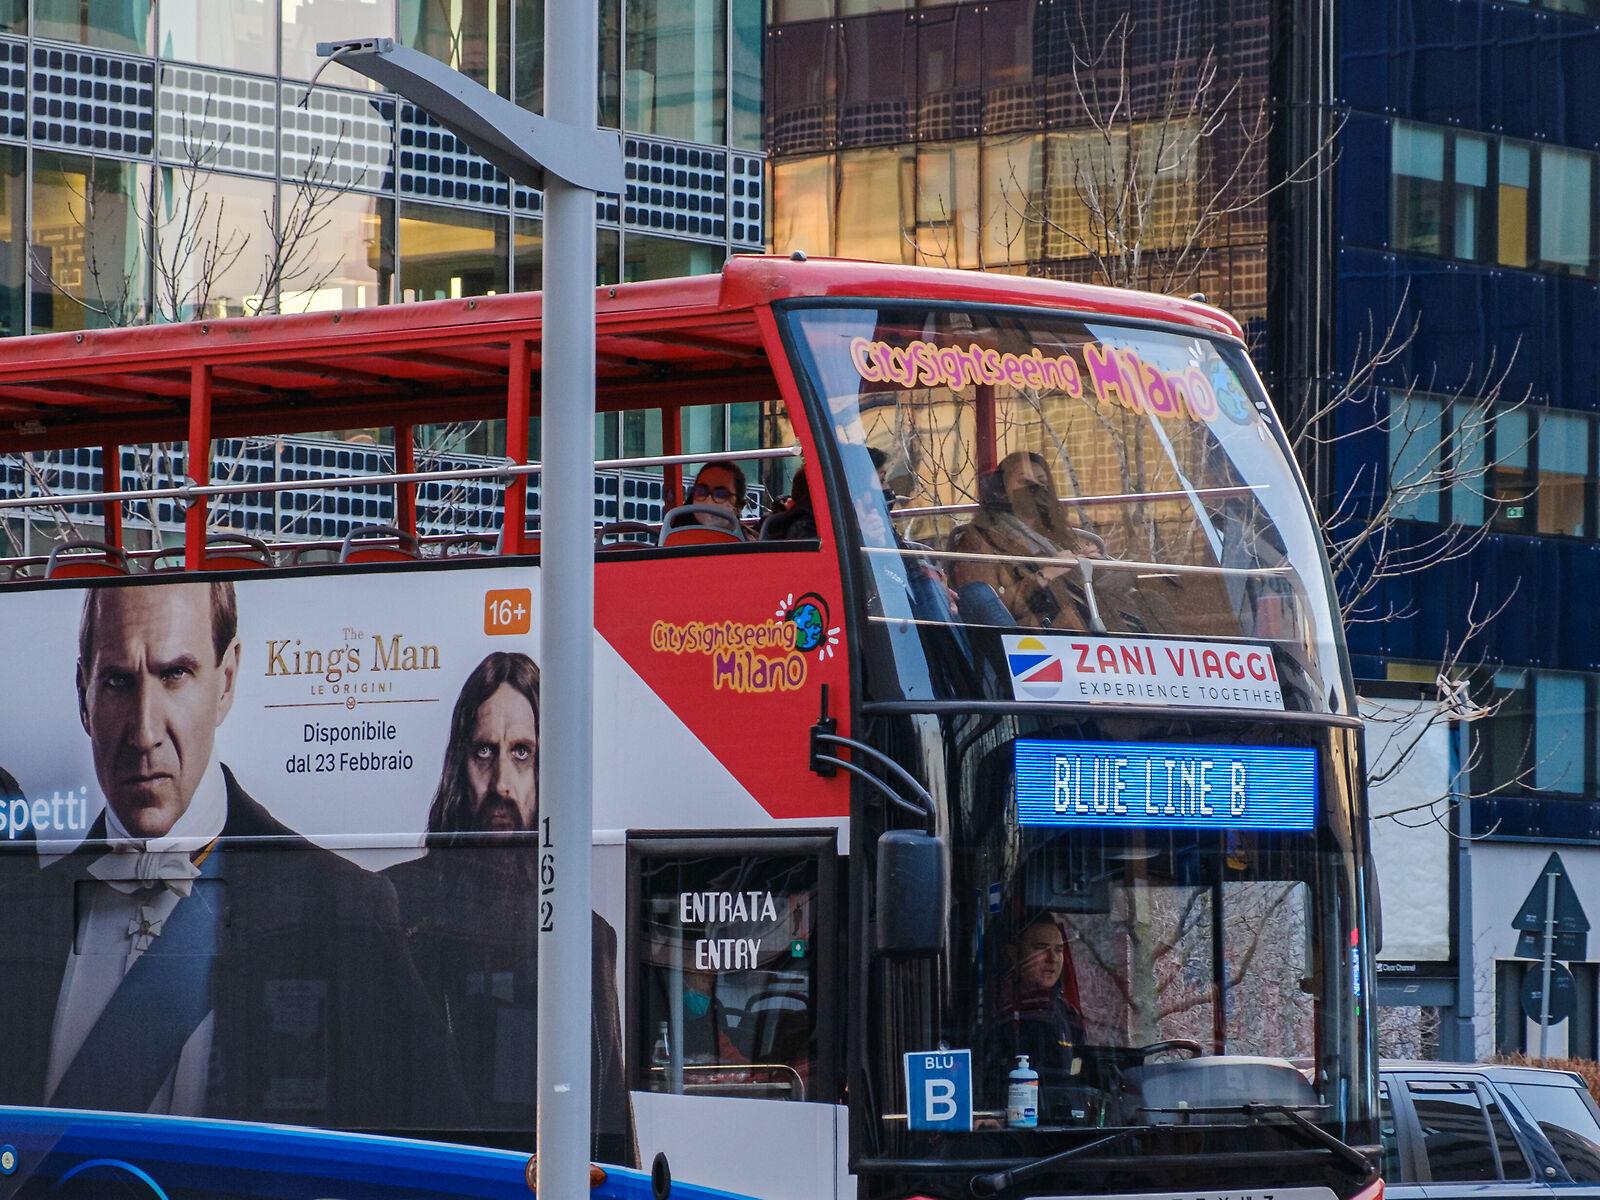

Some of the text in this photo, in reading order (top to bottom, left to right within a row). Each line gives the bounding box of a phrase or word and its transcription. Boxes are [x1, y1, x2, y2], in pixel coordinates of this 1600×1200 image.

[1083, 342, 1218, 424] Milano
[489, 599, 526, 625] 16+
[343, 628, 364, 640] The
[264, 634, 441, 683] King's Man
[713, 649, 807, 693] Milano
[1072, 643, 1278, 682] ZANI VIAGGI
[311, 682, 393, 695] LE ORIGINI
[1080, 682, 1282, 703] EXPERIENCE TOGETHER
[303, 720, 396, 746] Disponibile
[286, 750, 413, 773] dal 23 Febbraio
[1055, 756, 1247, 817] BLUE LINE B
[680, 891, 777, 923] ENTRATA
[696, 938, 761, 970] ENTRY
[925, 1056, 954, 1069] BLU
[925, 1079, 957, 1121] B
